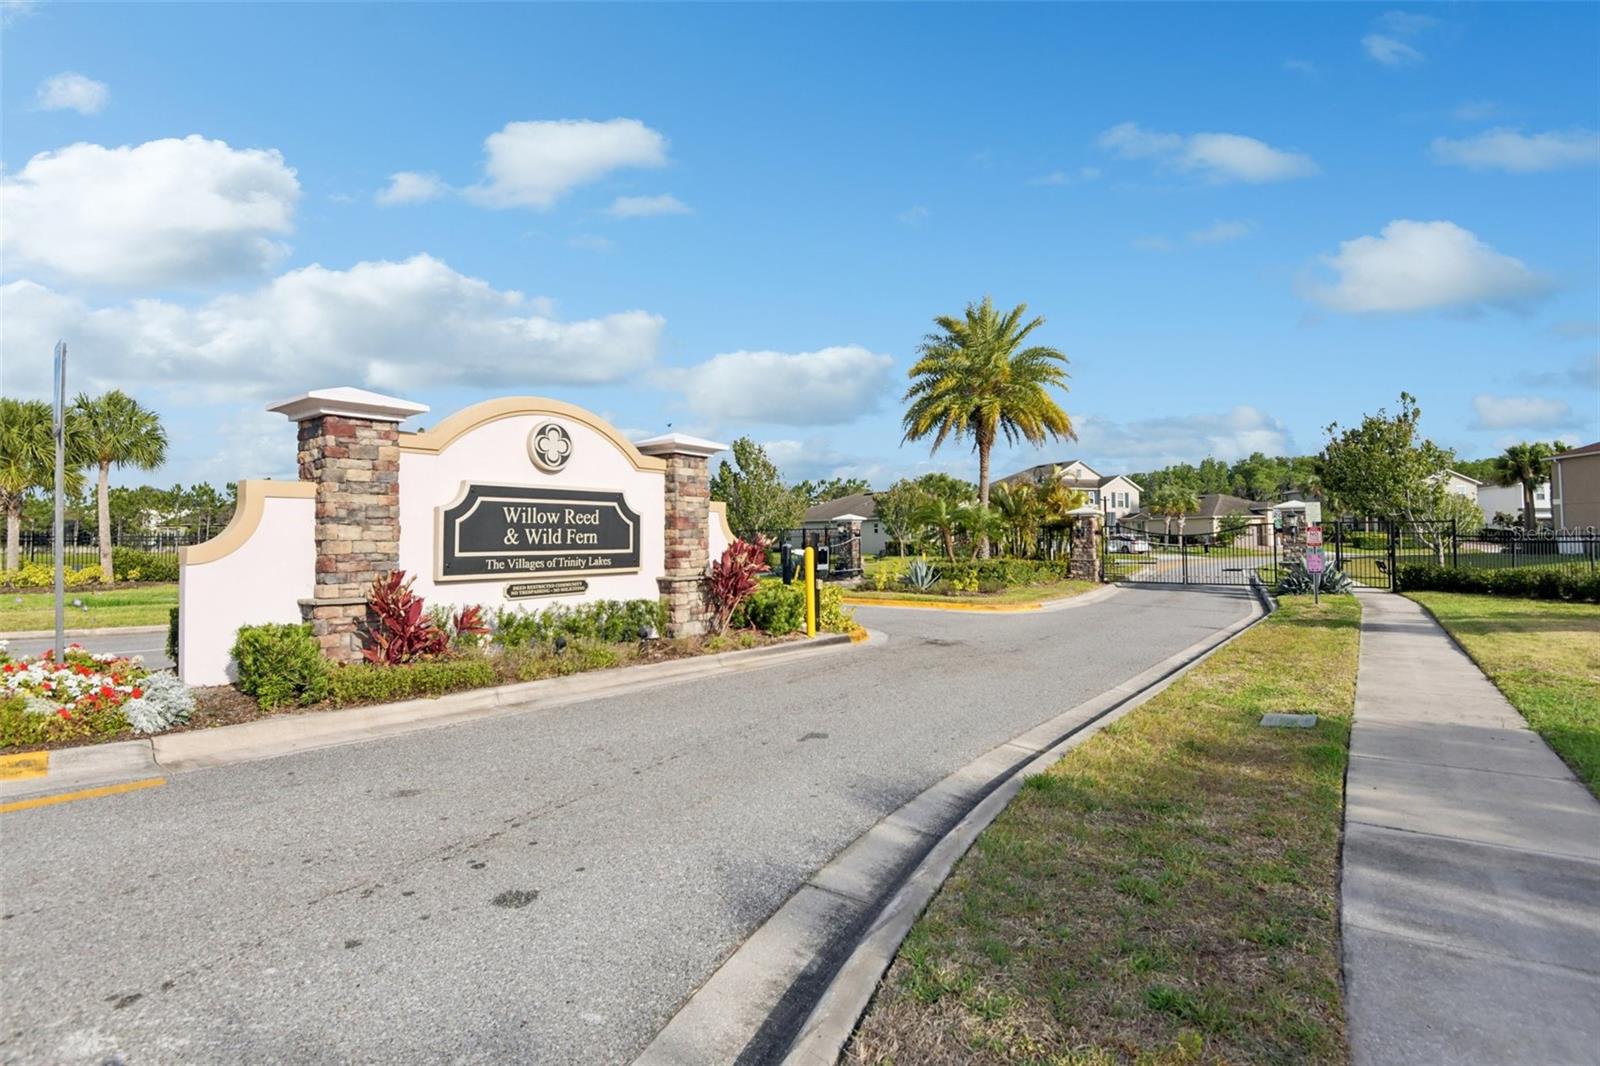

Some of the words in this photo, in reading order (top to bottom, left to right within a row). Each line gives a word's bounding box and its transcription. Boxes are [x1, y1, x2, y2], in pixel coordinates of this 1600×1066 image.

[503, 506, 561, 524] Willow
[564, 509, 600, 525] Reed
[503, 527, 520, 545] &
[524, 528, 562, 545] Wild
[566, 529, 599, 545] Fern
[486, 559, 505, 570] The
[507, 557, 545, 571] Villages
[546, 557, 559, 568] of
[558, 557, 587, 569] Trinity
[588, 556, 612, 566] Lakes
